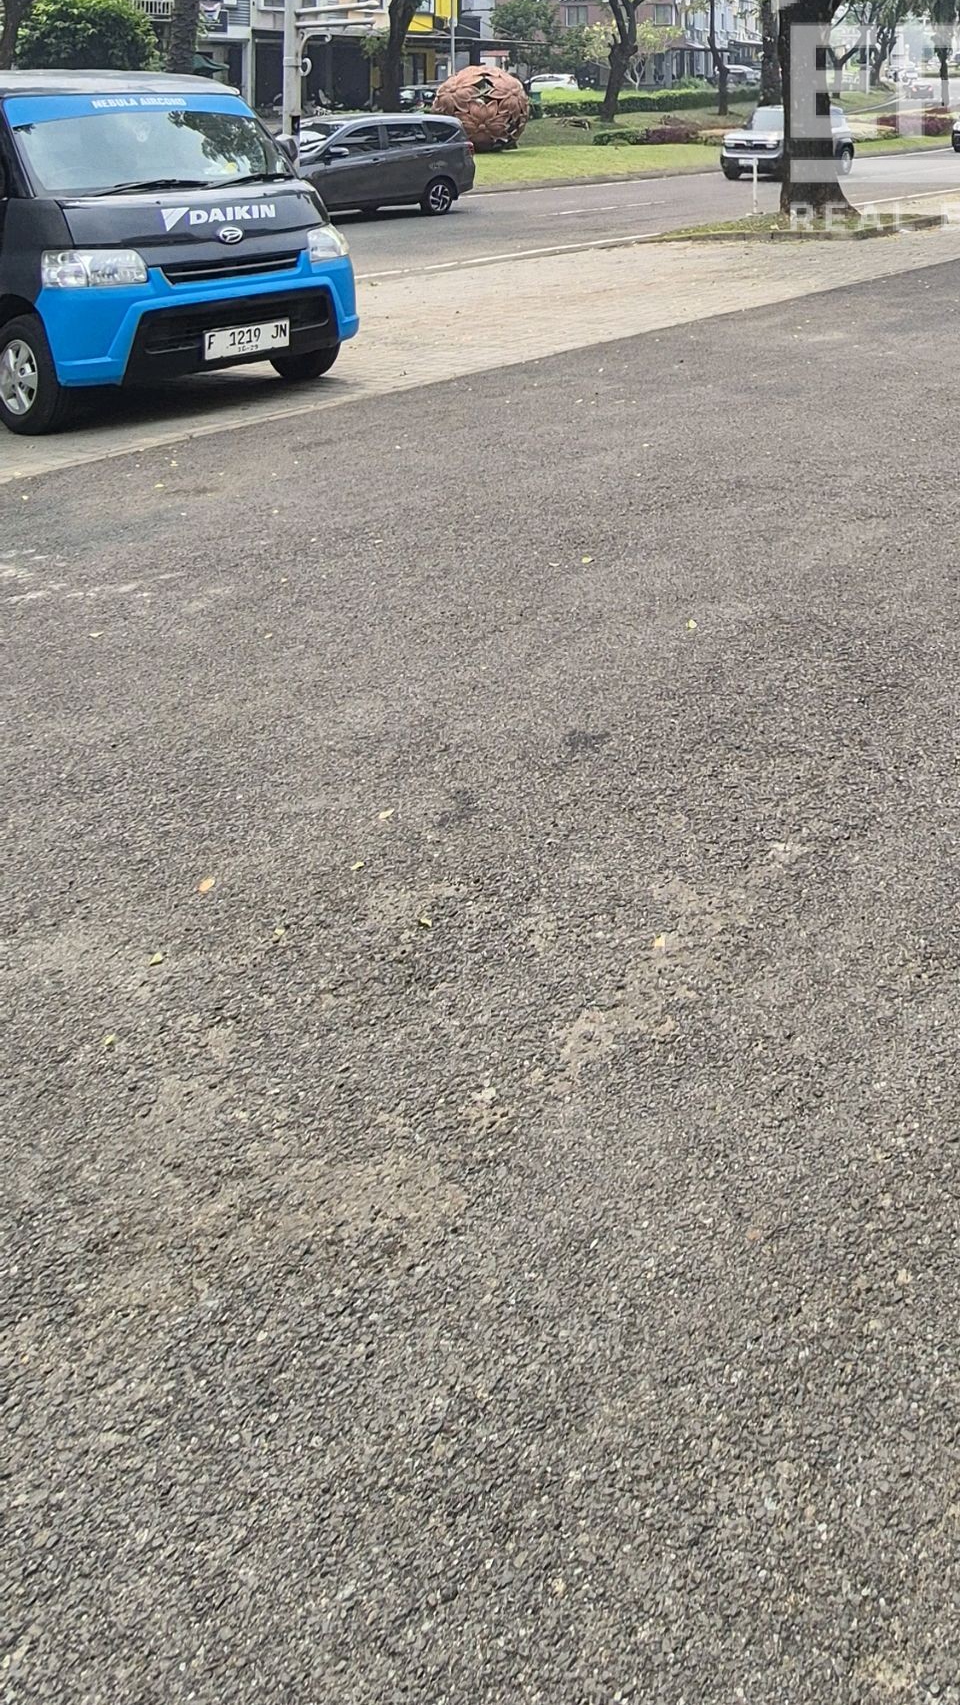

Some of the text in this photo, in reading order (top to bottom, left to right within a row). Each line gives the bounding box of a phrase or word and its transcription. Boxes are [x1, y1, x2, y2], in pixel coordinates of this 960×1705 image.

[91, 98, 138, 109] NEBULA
[189, 204, 276, 225] DAIKIN
[207, 323, 287, 350] F 1219 JN
